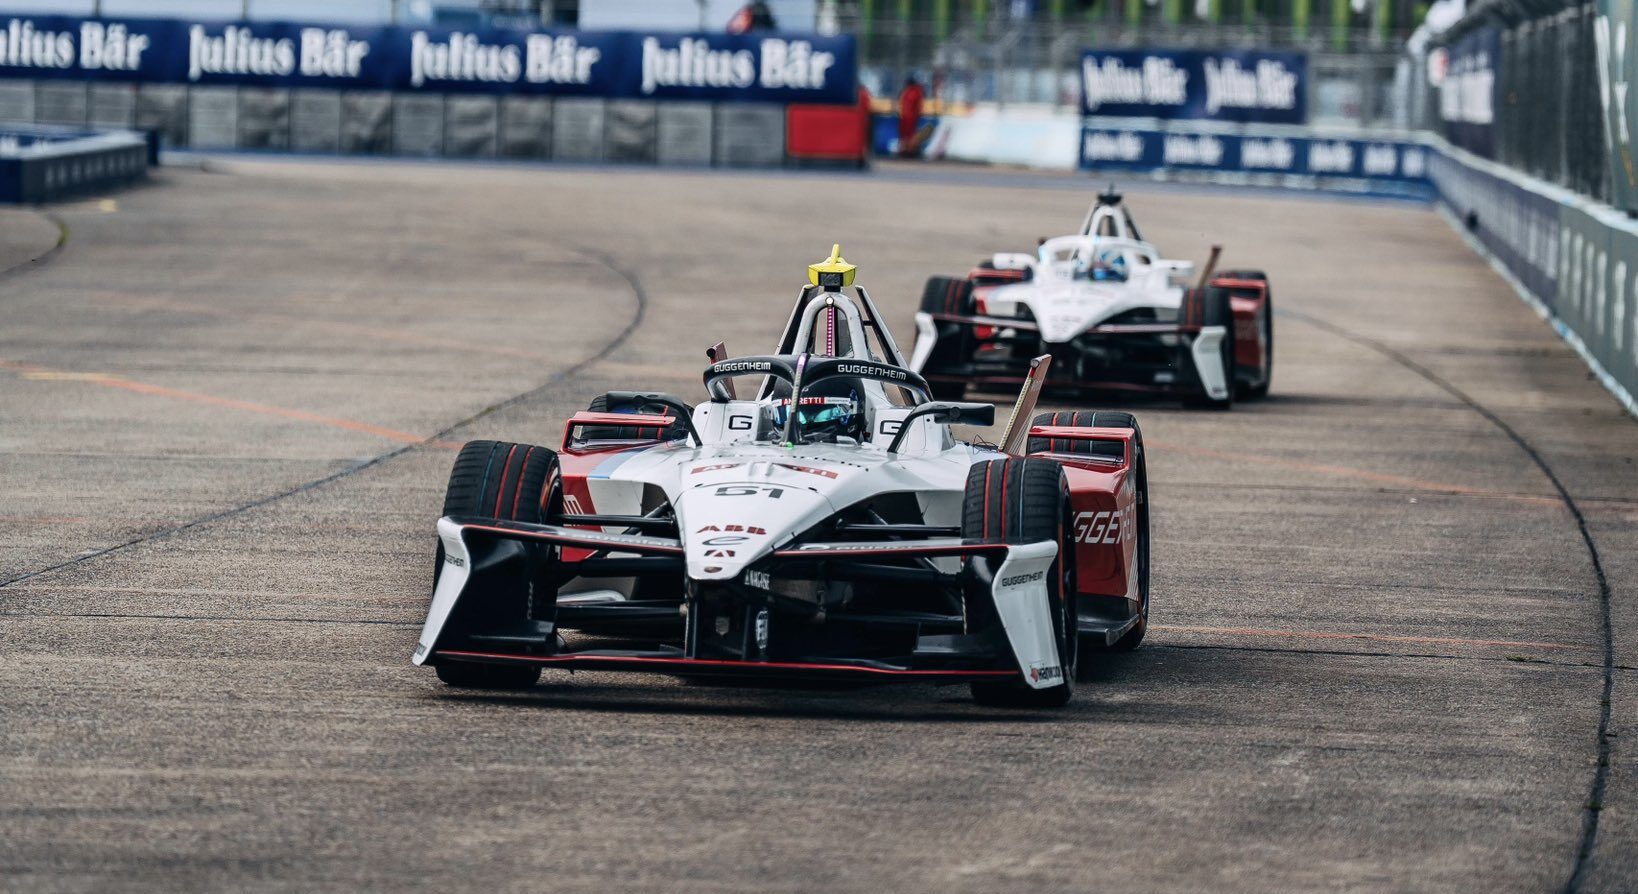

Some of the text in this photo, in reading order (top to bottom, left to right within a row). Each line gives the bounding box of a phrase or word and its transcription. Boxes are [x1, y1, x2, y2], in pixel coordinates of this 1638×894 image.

[0, 18, 149, 70] lius Bär
[188, 24, 370, 81] Julius Bär
[410, 30, 599, 88] Julius Bär
[641, 36, 835, 94] Julius Bär
[714, 361, 771, 373] GUGGENHEIM
[837, 364, 907, 381] GUGGENHEIM
[783, 397, 823, 406] ANRETTI
[728, 415, 752, 431] G
[714, 486, 784, 499] 51
[696, 525, 767, 535] ABB
[1002, 571, 1043, 587] GUGGENHEIM
